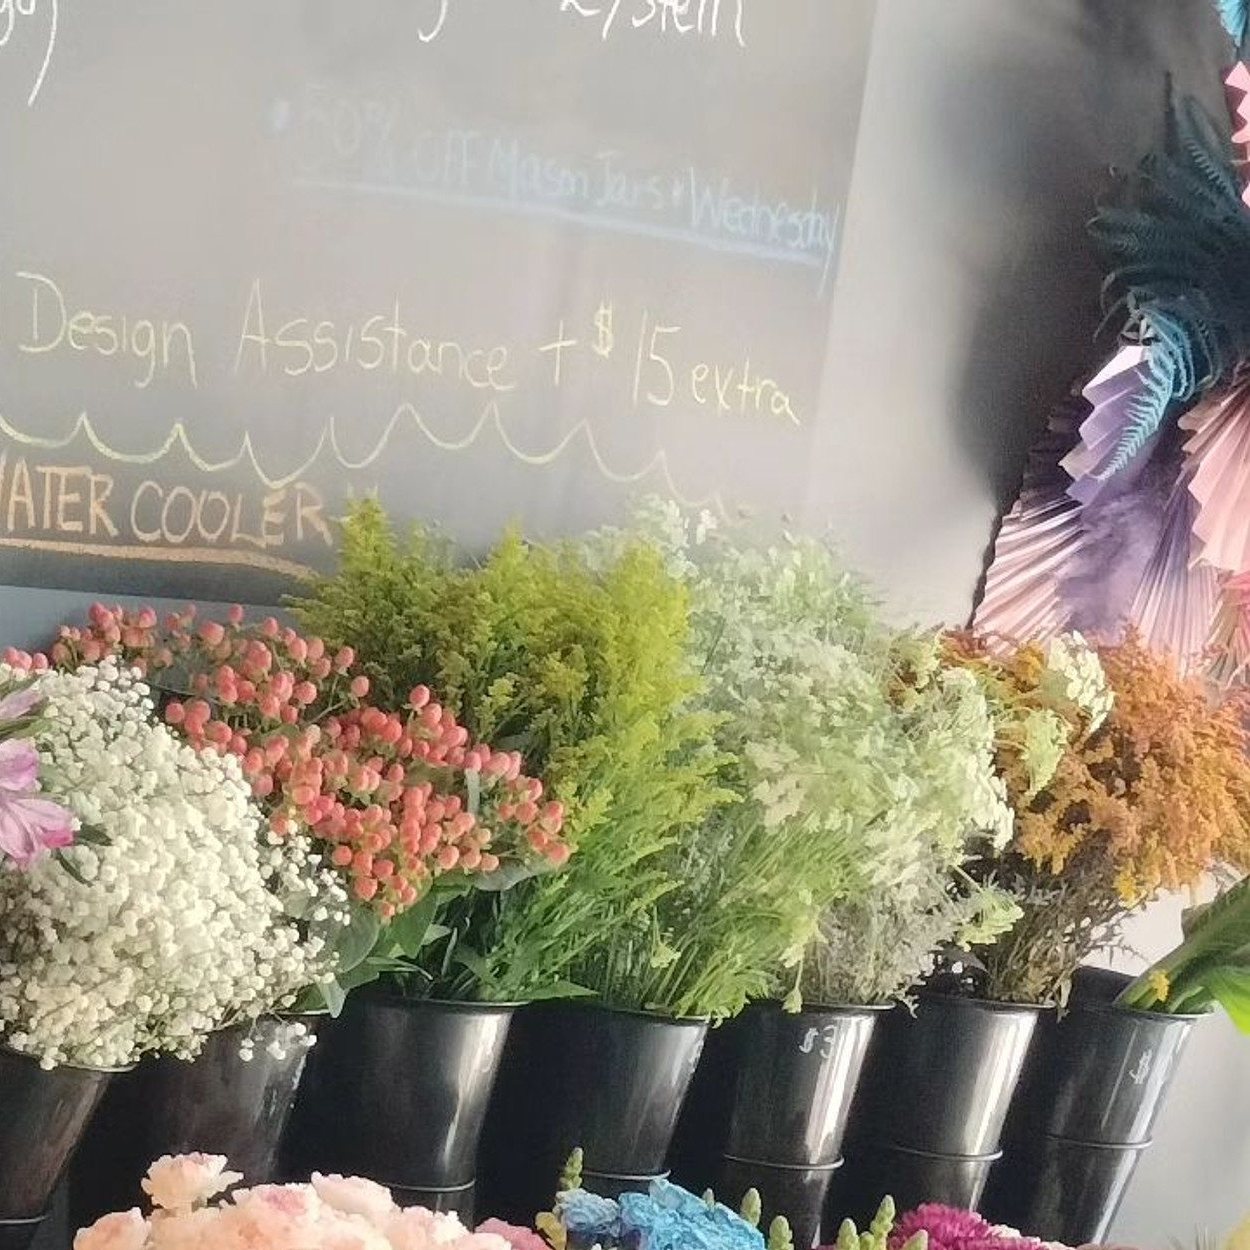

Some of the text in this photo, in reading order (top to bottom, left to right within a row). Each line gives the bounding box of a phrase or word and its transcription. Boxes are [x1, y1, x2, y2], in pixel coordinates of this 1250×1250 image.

[17, 271, 197, 390] Design
[234, 277, 517, 392] Assistance
[692, 350, 801, 426] extra
[130, 480, 334, 548] COOLER
